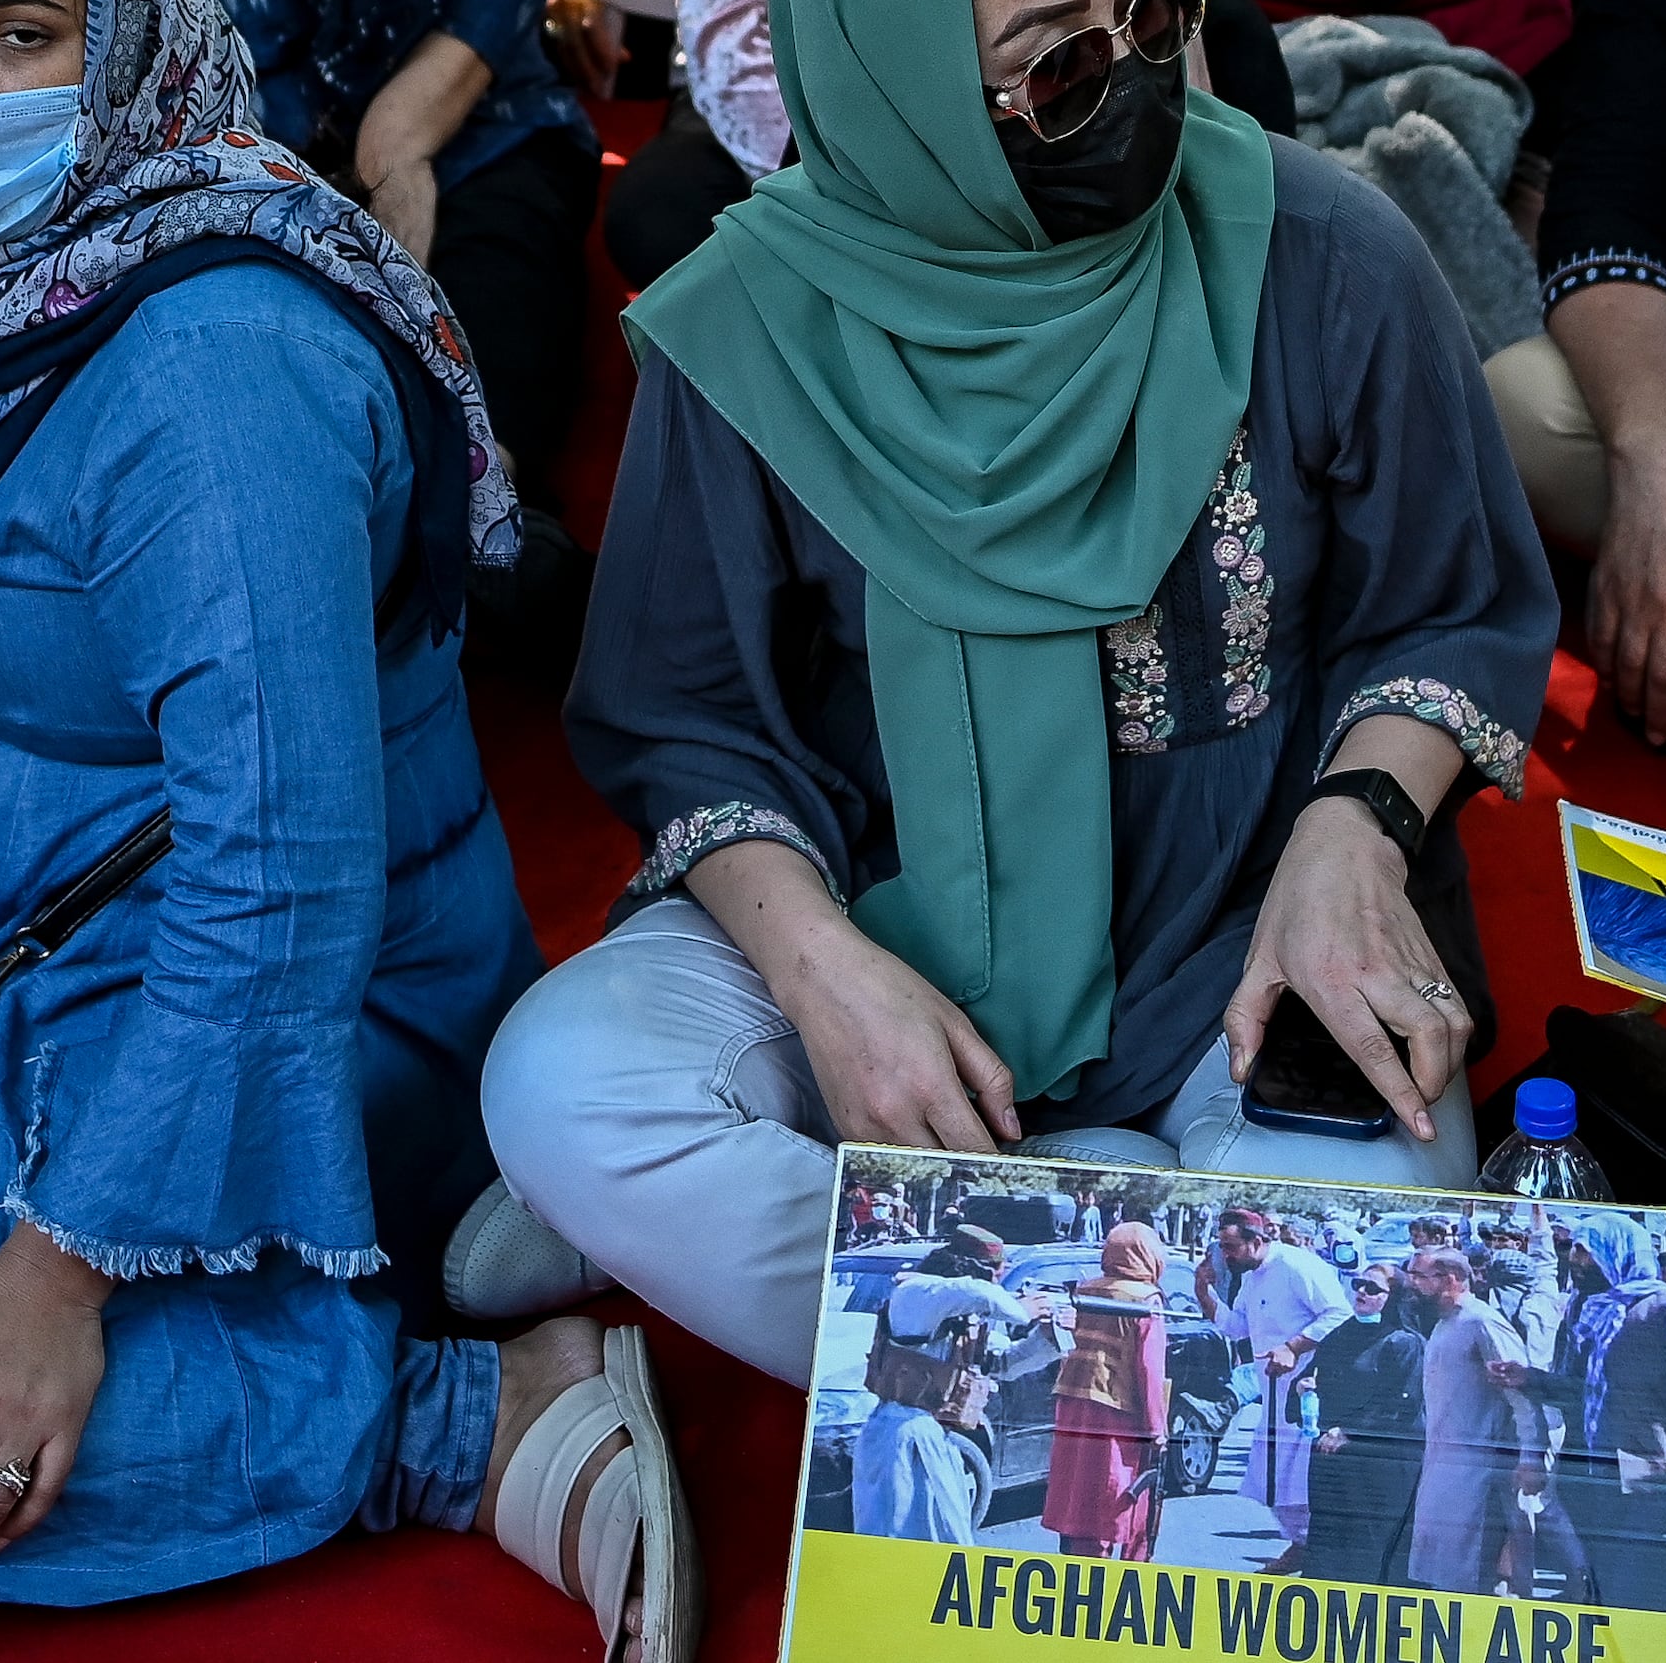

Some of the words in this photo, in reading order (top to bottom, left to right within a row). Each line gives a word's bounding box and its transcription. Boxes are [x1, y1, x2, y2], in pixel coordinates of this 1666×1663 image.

[930, 1551, 1197, 1650] AFGHAN
[1215, 1577, 1462, 1663] WOMEN
[1483, 1604, 1611, 1663] ARE
